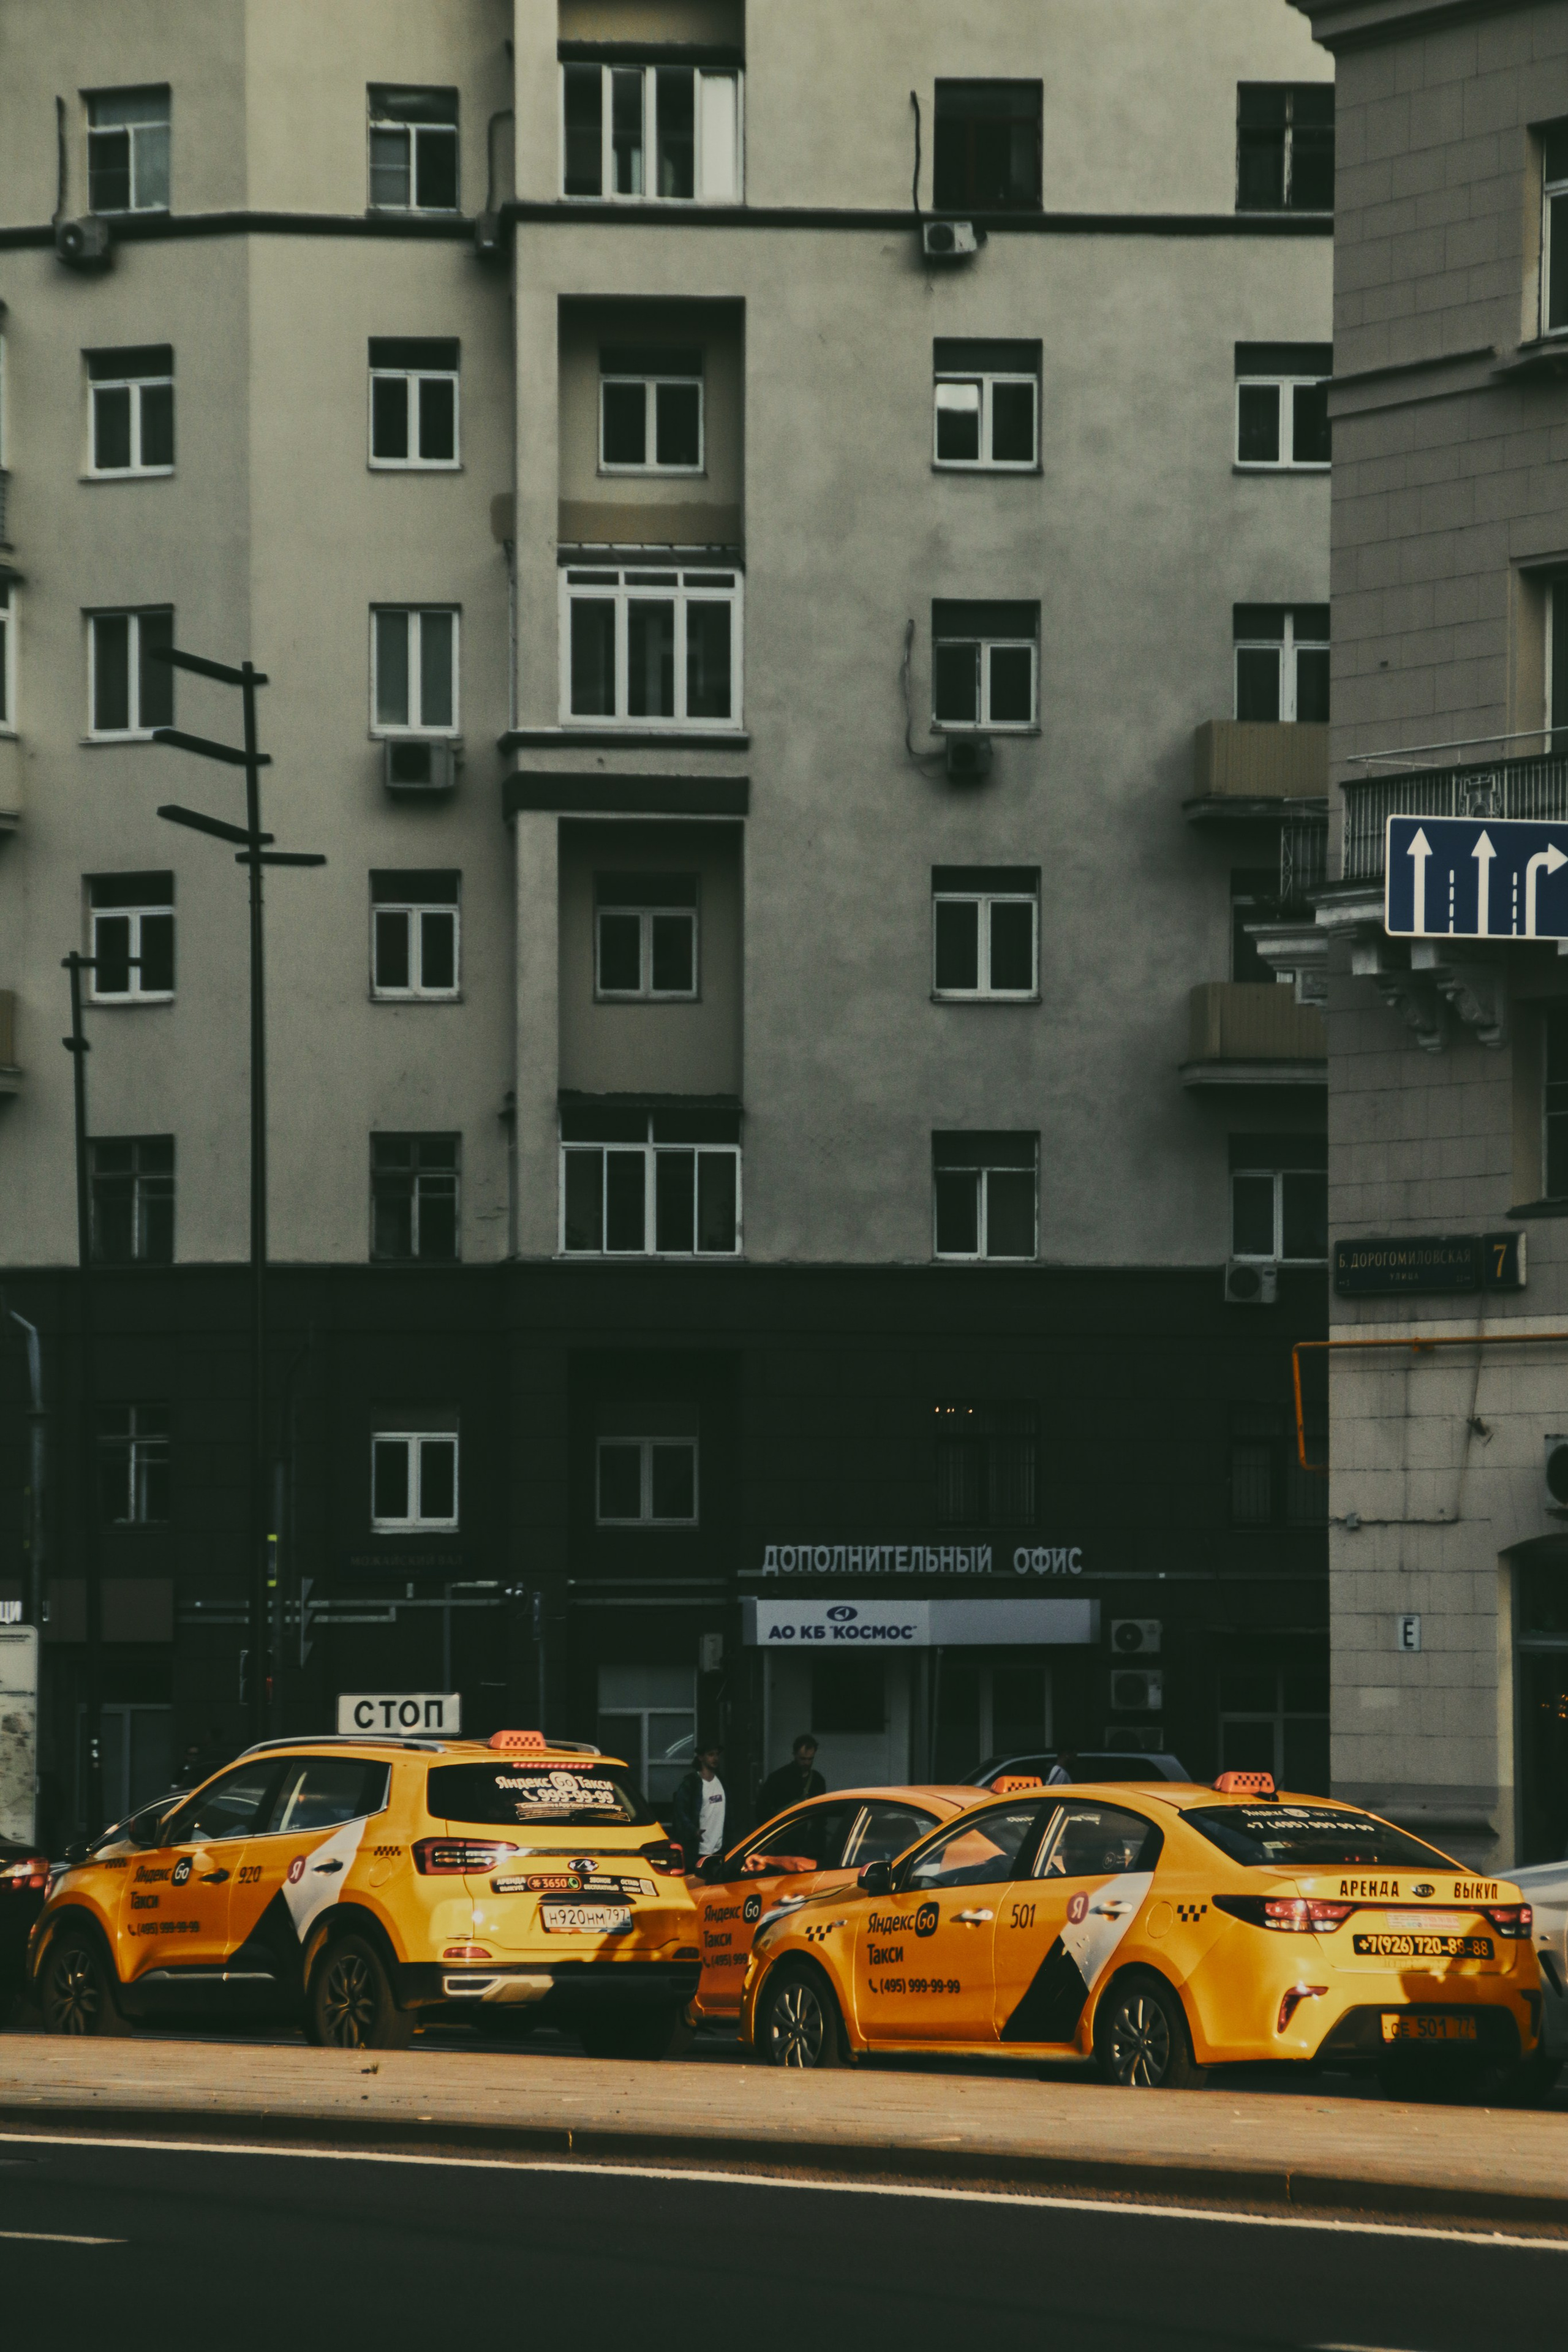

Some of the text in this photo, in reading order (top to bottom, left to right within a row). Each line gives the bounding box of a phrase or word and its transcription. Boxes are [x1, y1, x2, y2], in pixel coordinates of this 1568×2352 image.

[1351, 1248, 1471, 1268] ДОРОГОМИЛОВСКАЯ
[1493, 1243, 1507, 1277] 7
[1390, 1272, 1419, 1281] УЛИЦА
[762, 1544, 1083, 1576] ДОПОЛНИТЕЛЬНЫЙ ОФИС
[769, 1626, 796, 1639] АО
[801, 1626, 826, 1639] КБ
[354, 1700, 443, 1728] СТОП
[496, 1776, 552, 1789] Яндекс
[574, 1776, 614, 1790] Такси
[537, 1789, 614, 1804] 999-99-99
[134, 1863, 189, 1884] Яндекс Go
[238, 1866, 262, 1883] 920
[290, 1861, 302, 1879] Я
[1340, 1880, 1400, 1897] АРЕНДА
[1454, 1882, 1498, 1899] ВЫКУП
[130, 1891, 159, 1909] Такси
[1071, 1897, 1085, 1919] Я
[704, 1901, 759, 1923] Яндекс Go
[867, 1909, 935, 1933] Яндекс Go
[1011, 1904, 1036, 1928] 501
[137, 1921, 158, 1936] (495)
[703, 1931, 732, 1948] Такси
[867, 1944, 903, 1965] Такси
[880, 1978, 960, 1994] (495) 999-99-99
[1417, 2018, 1447, 2037] 501
